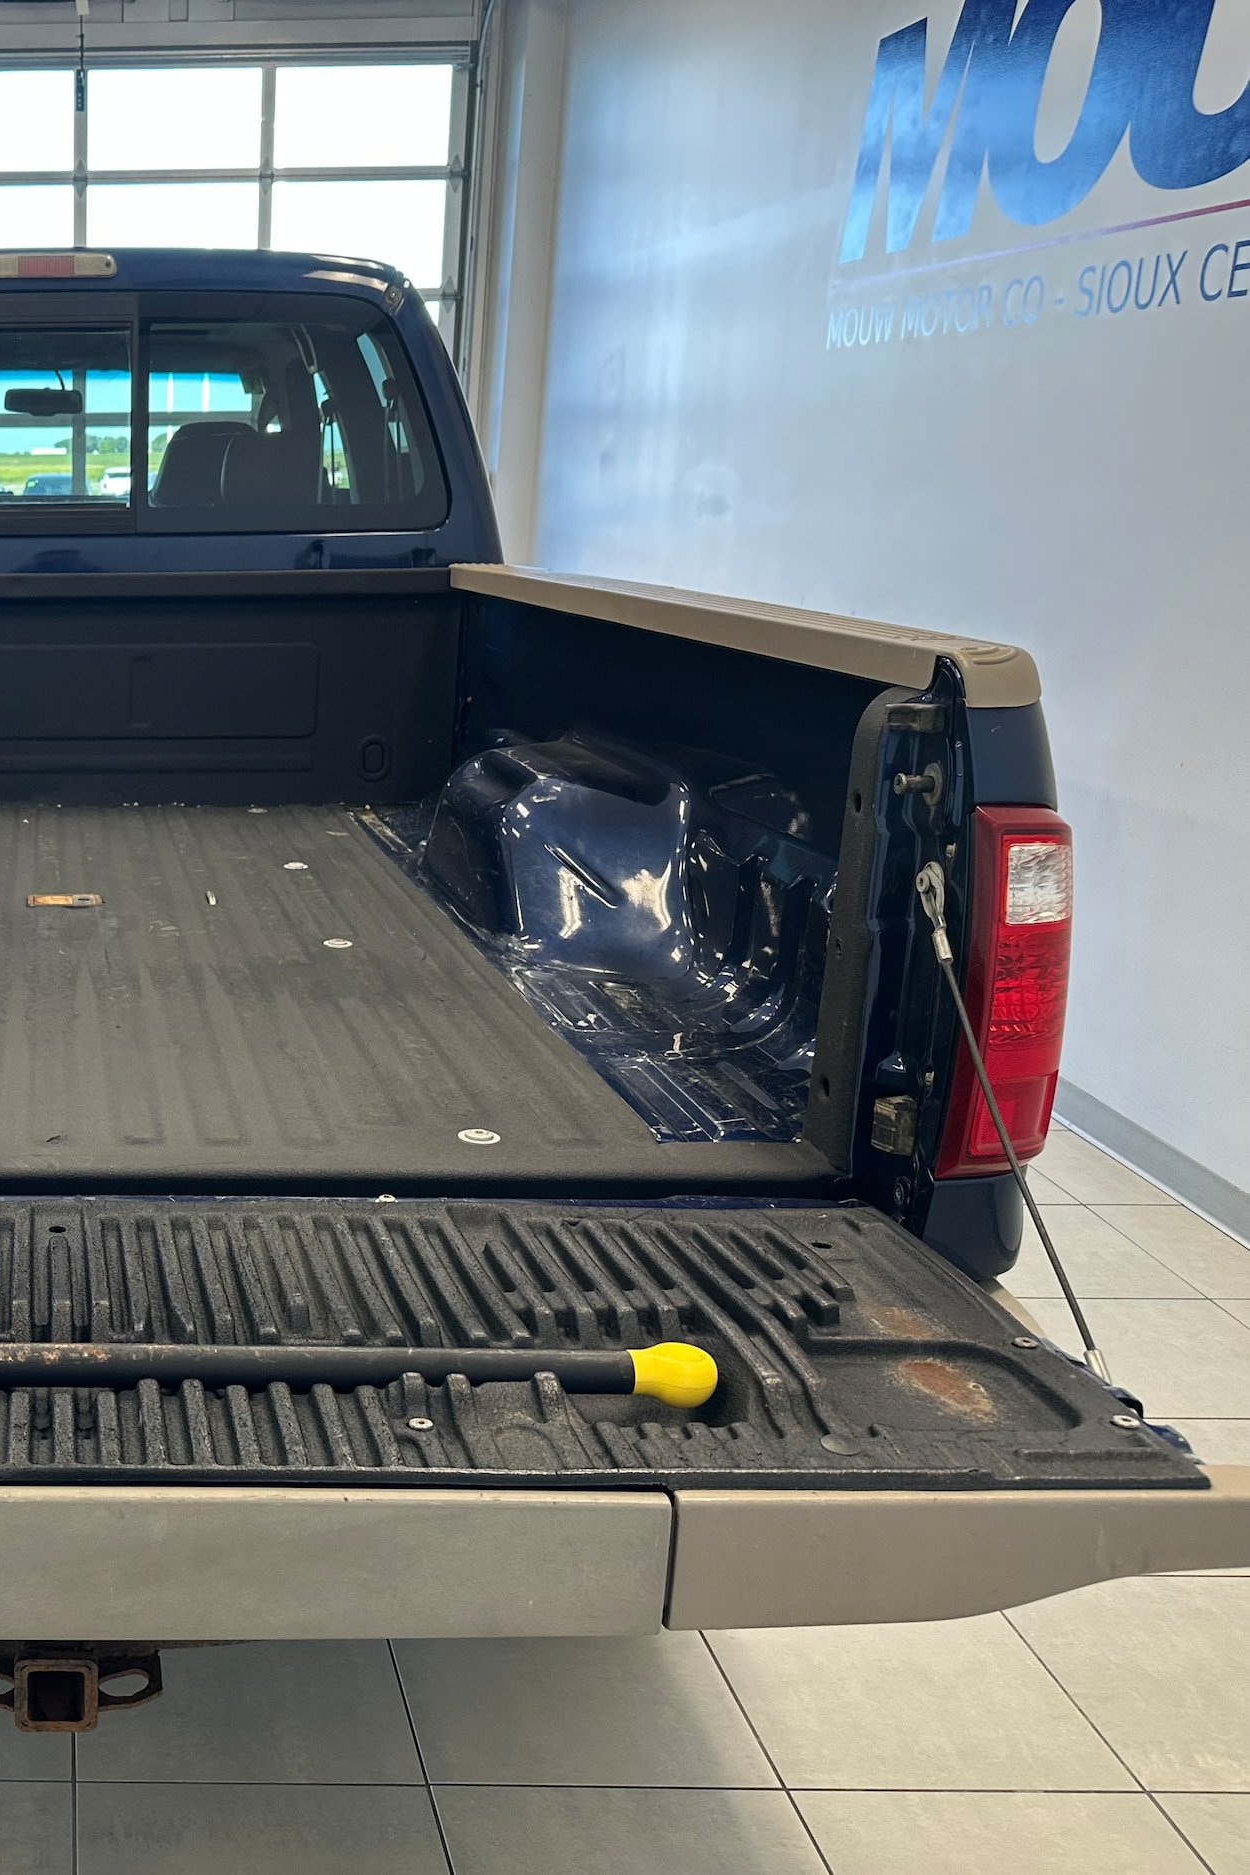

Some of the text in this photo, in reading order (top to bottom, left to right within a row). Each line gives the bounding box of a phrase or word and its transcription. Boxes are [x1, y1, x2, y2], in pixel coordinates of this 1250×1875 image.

[826, 301, 895, 349] MOUW
[901, 284, 993, 339] MOTOR
[1002, 275, 1044, 326] CO
[1075, 250, 1189, 316] SIOUX
